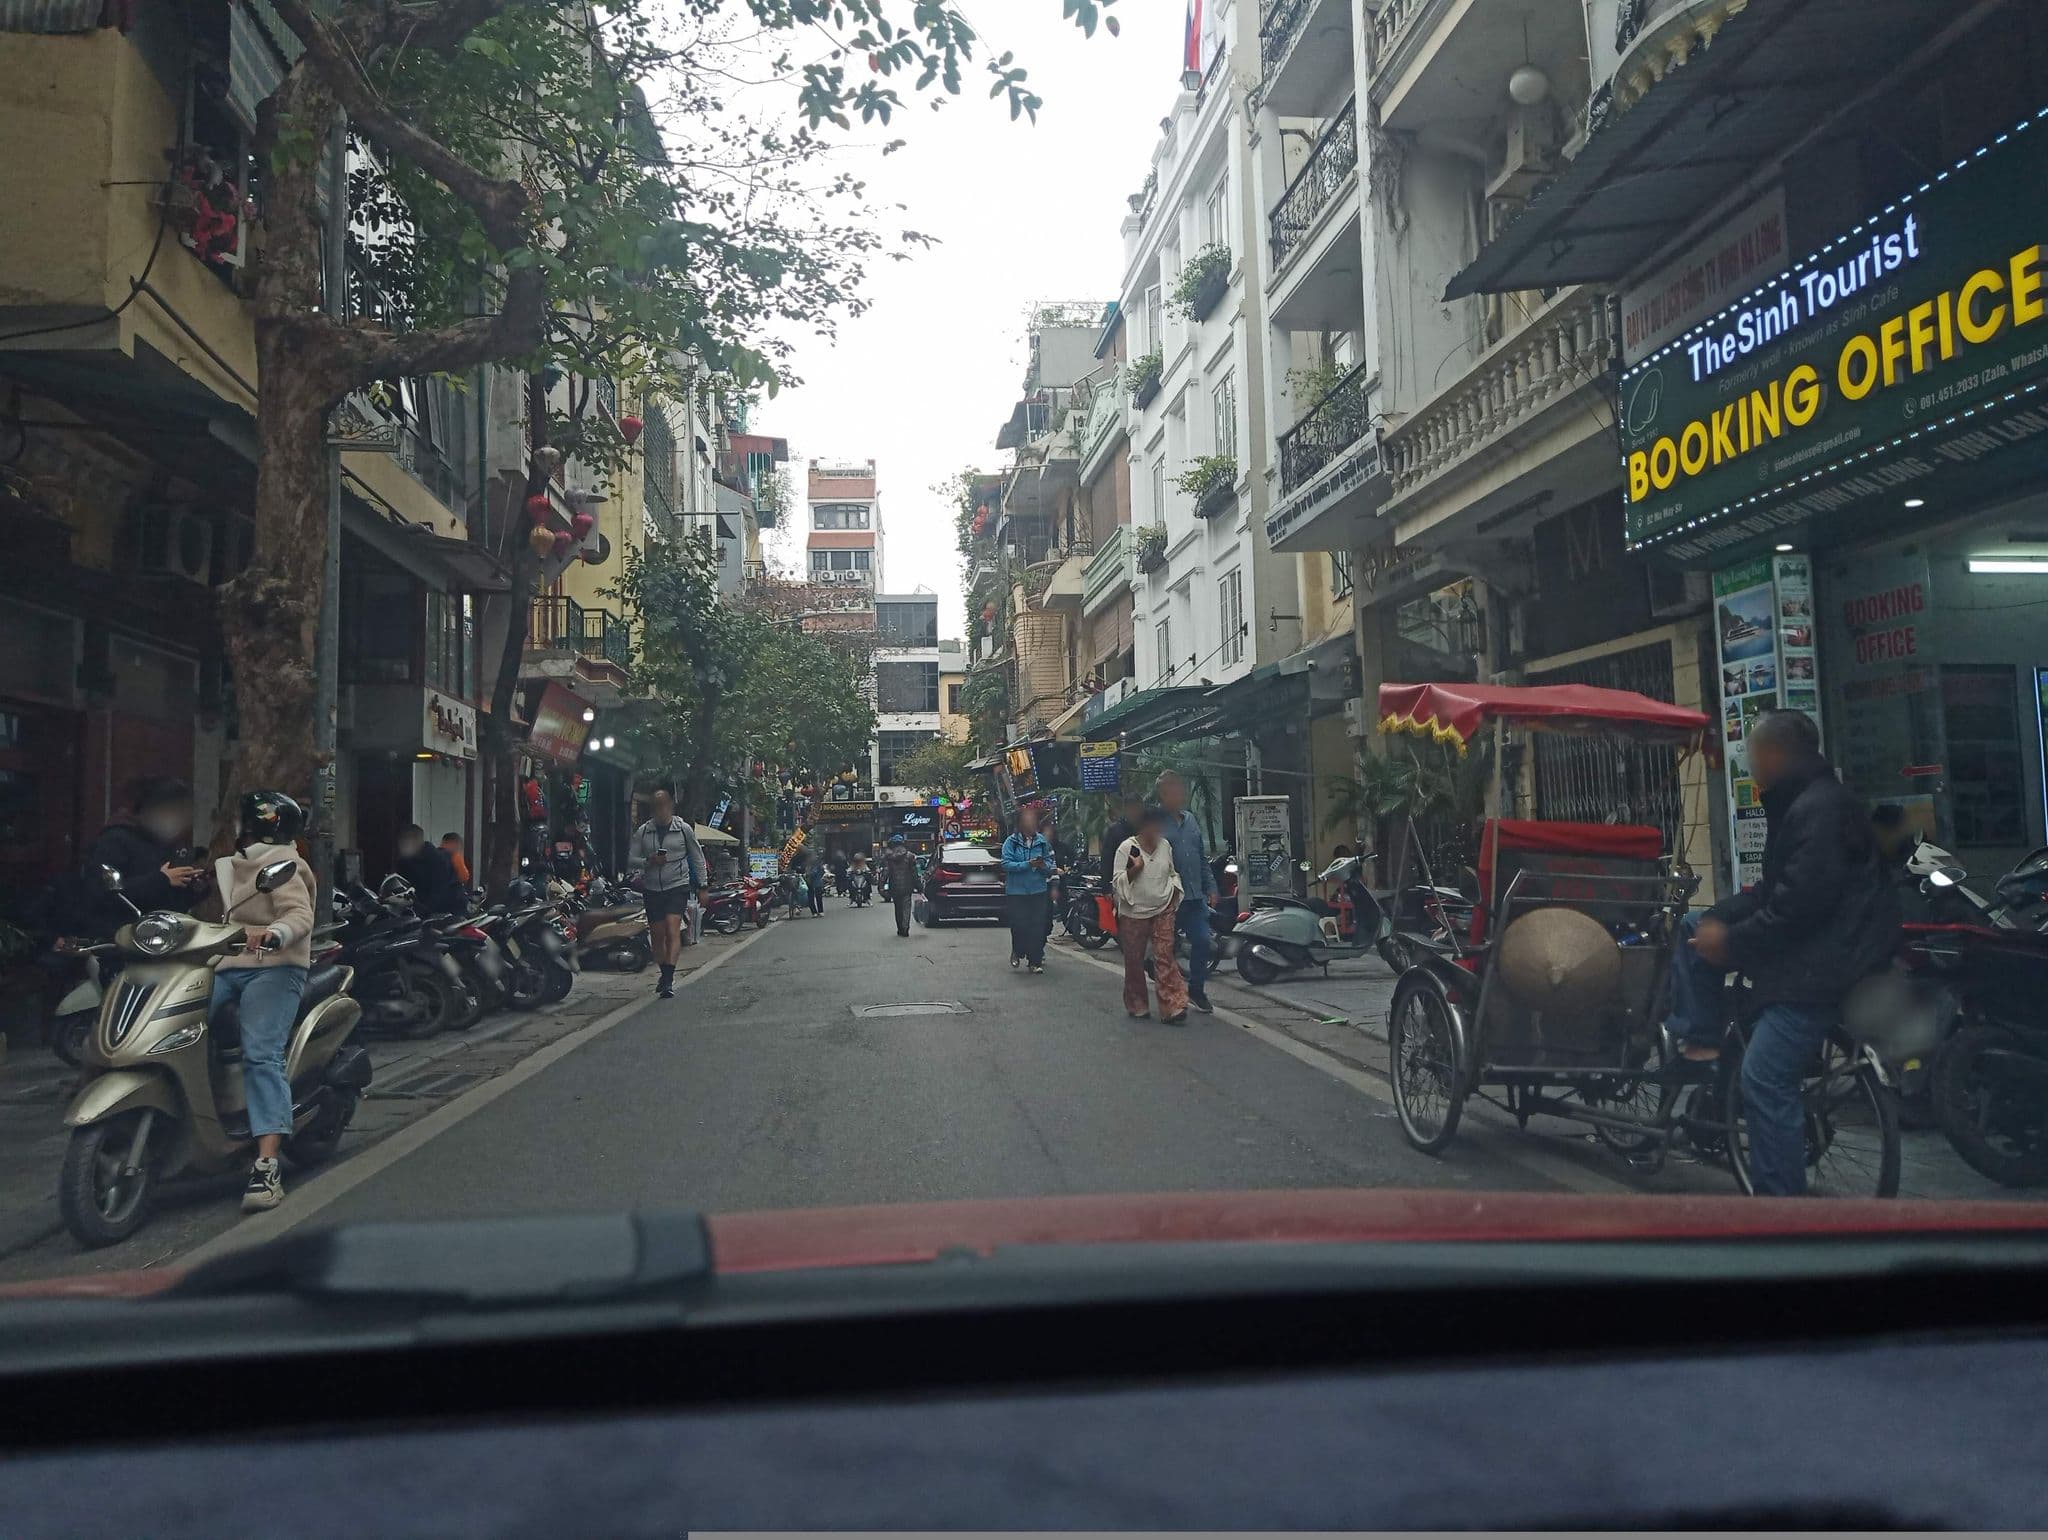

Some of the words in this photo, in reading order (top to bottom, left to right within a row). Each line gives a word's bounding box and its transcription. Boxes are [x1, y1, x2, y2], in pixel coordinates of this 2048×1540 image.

[1842, 301, 1867, 327] Sinh
[1629, 364, 1820, 503] BOOKING
[1838, 244, 2045, 401] OFFICE
[1869, 455, 1937, 486] LONG
[1843, 583, 1923, 625] BOOKING
[1856, 627, 1917, 664] OFFICE
